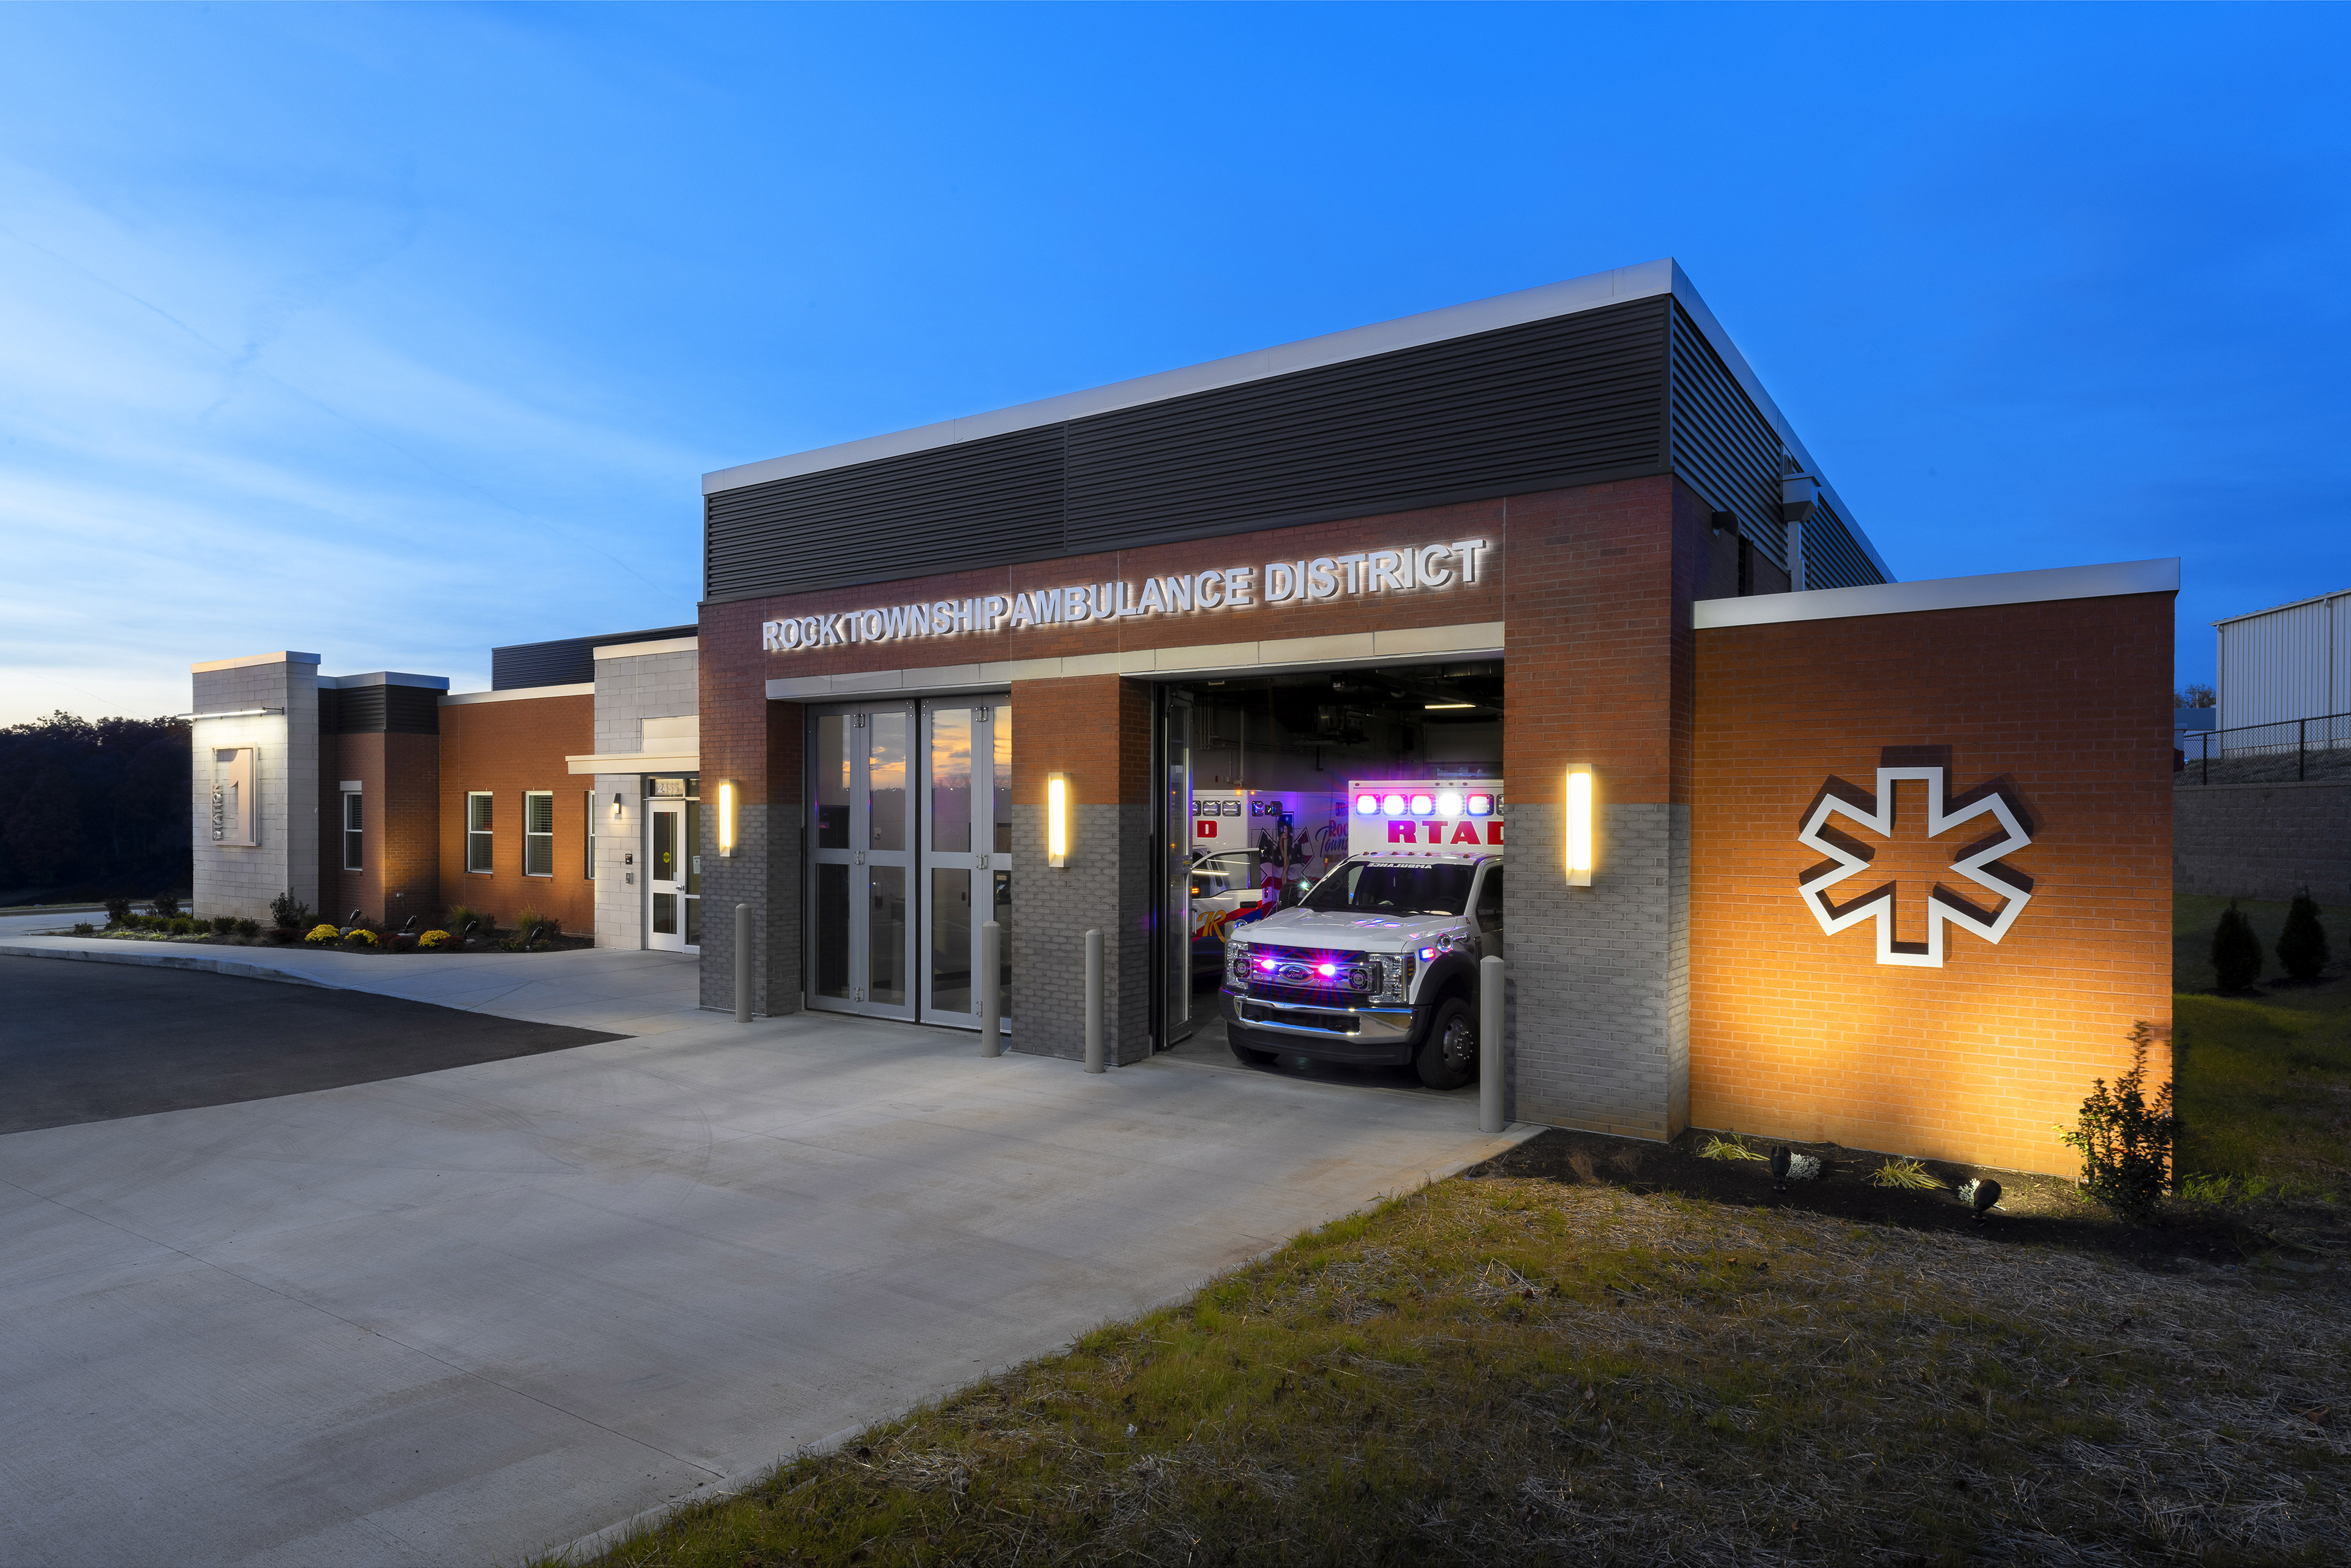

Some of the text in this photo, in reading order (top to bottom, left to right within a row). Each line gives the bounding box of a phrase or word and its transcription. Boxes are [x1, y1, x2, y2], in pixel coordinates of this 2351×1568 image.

[763, 539, 1486, 650] ROCK TOWNSHIP AMBULANCE DISTRICT
[229, 749, 253, 845] 1
[1287, 969, 1303, 978] Ford
